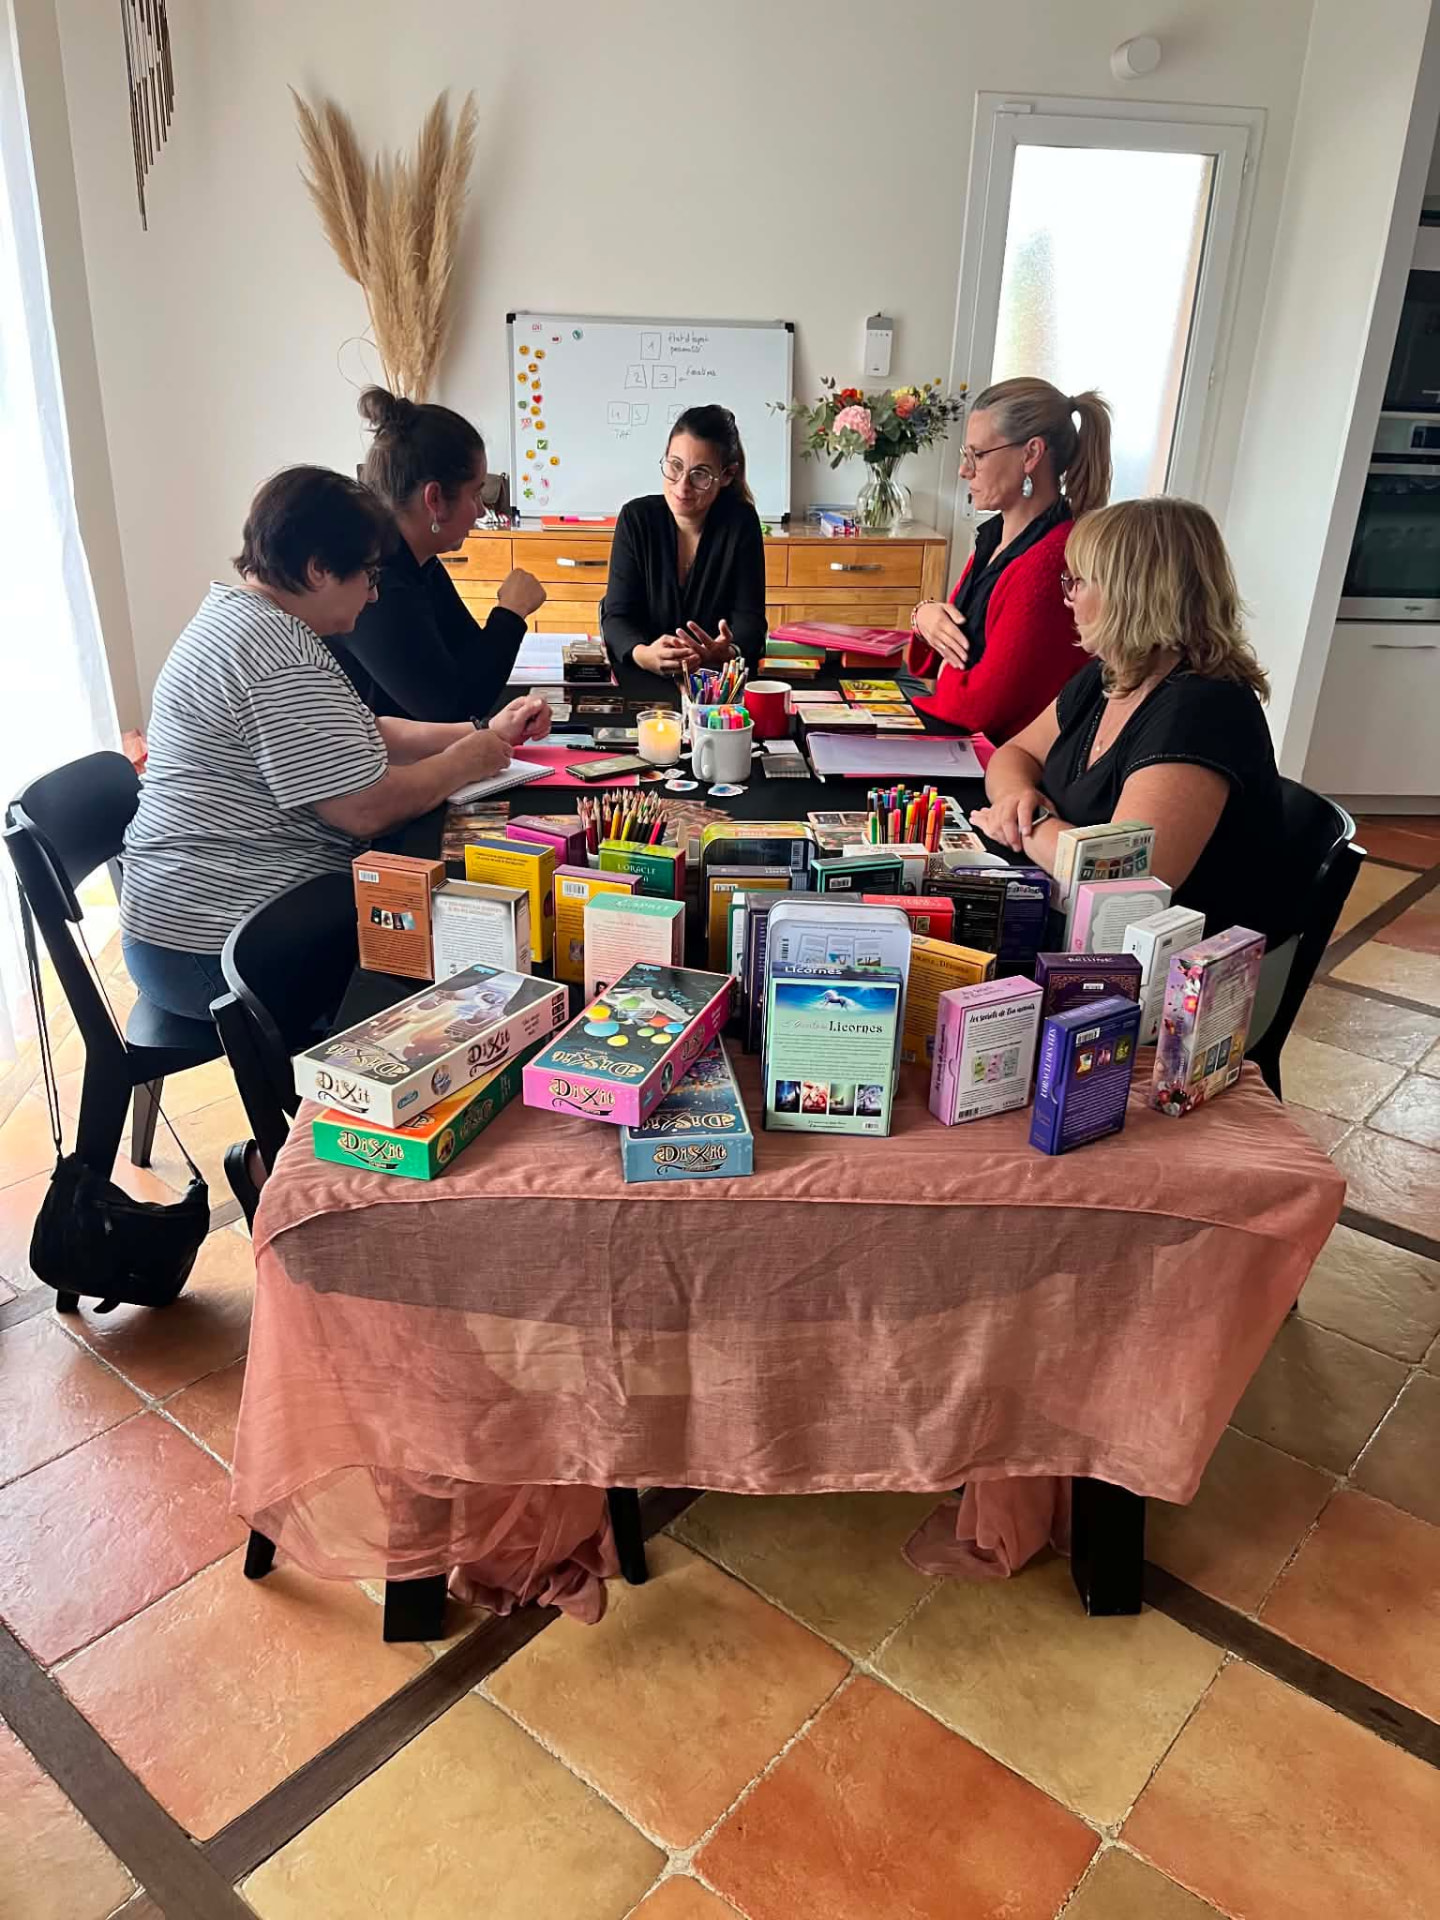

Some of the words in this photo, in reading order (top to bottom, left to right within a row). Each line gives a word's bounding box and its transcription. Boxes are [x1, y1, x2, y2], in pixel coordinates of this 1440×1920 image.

[633, 371, 643, 383] 2
[659, 373, 669, 382] 3
[828, 1020, 883, 1034] Licornes
